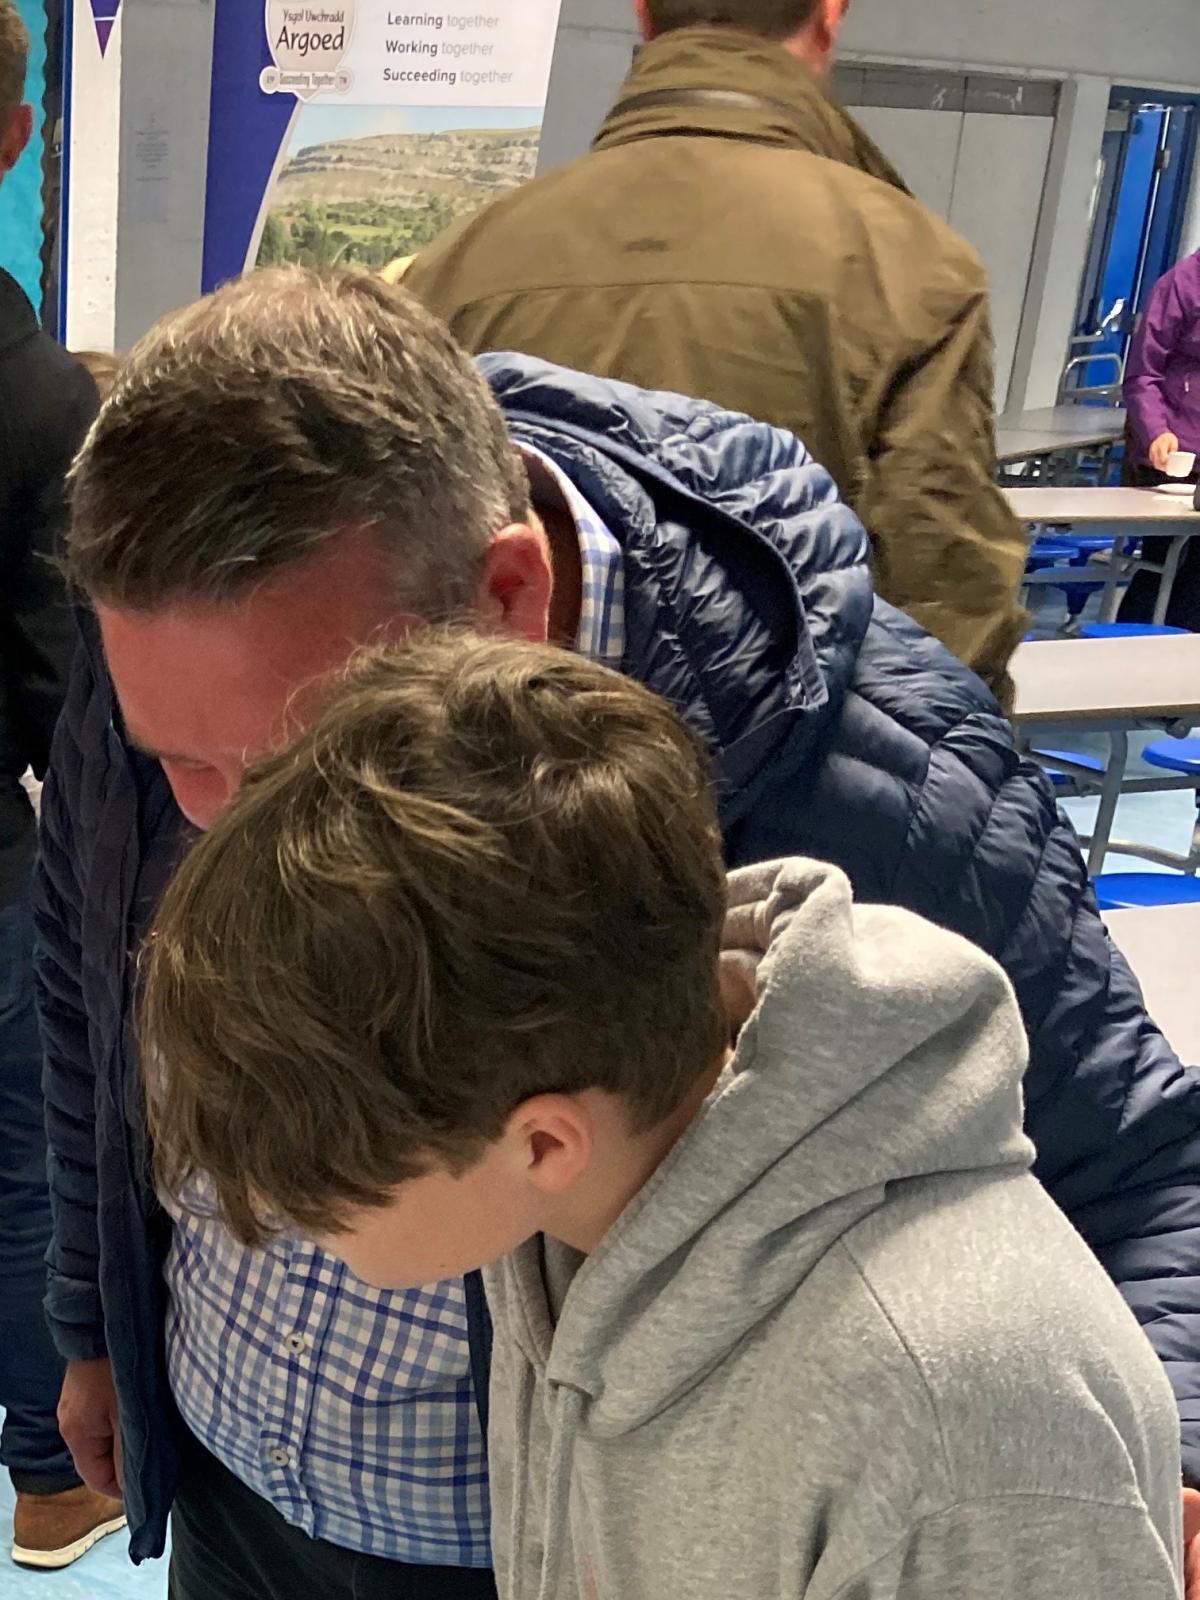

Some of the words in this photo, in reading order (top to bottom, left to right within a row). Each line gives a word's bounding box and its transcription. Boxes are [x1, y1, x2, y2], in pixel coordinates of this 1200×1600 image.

[283, 9, 304, 25] Ysgol
[306, 9, 345, 23] Uwchradd
[387, 11, 443, 29] Learning
[447, 13, 500, 31] together
[275, 25, 345, 57] Argoed
[385, 40, 438, 58] Working
[441, 41, 495, 59] together
[383, 67, 457, 86] Succeeding
[460, 70, 513, 87] together
